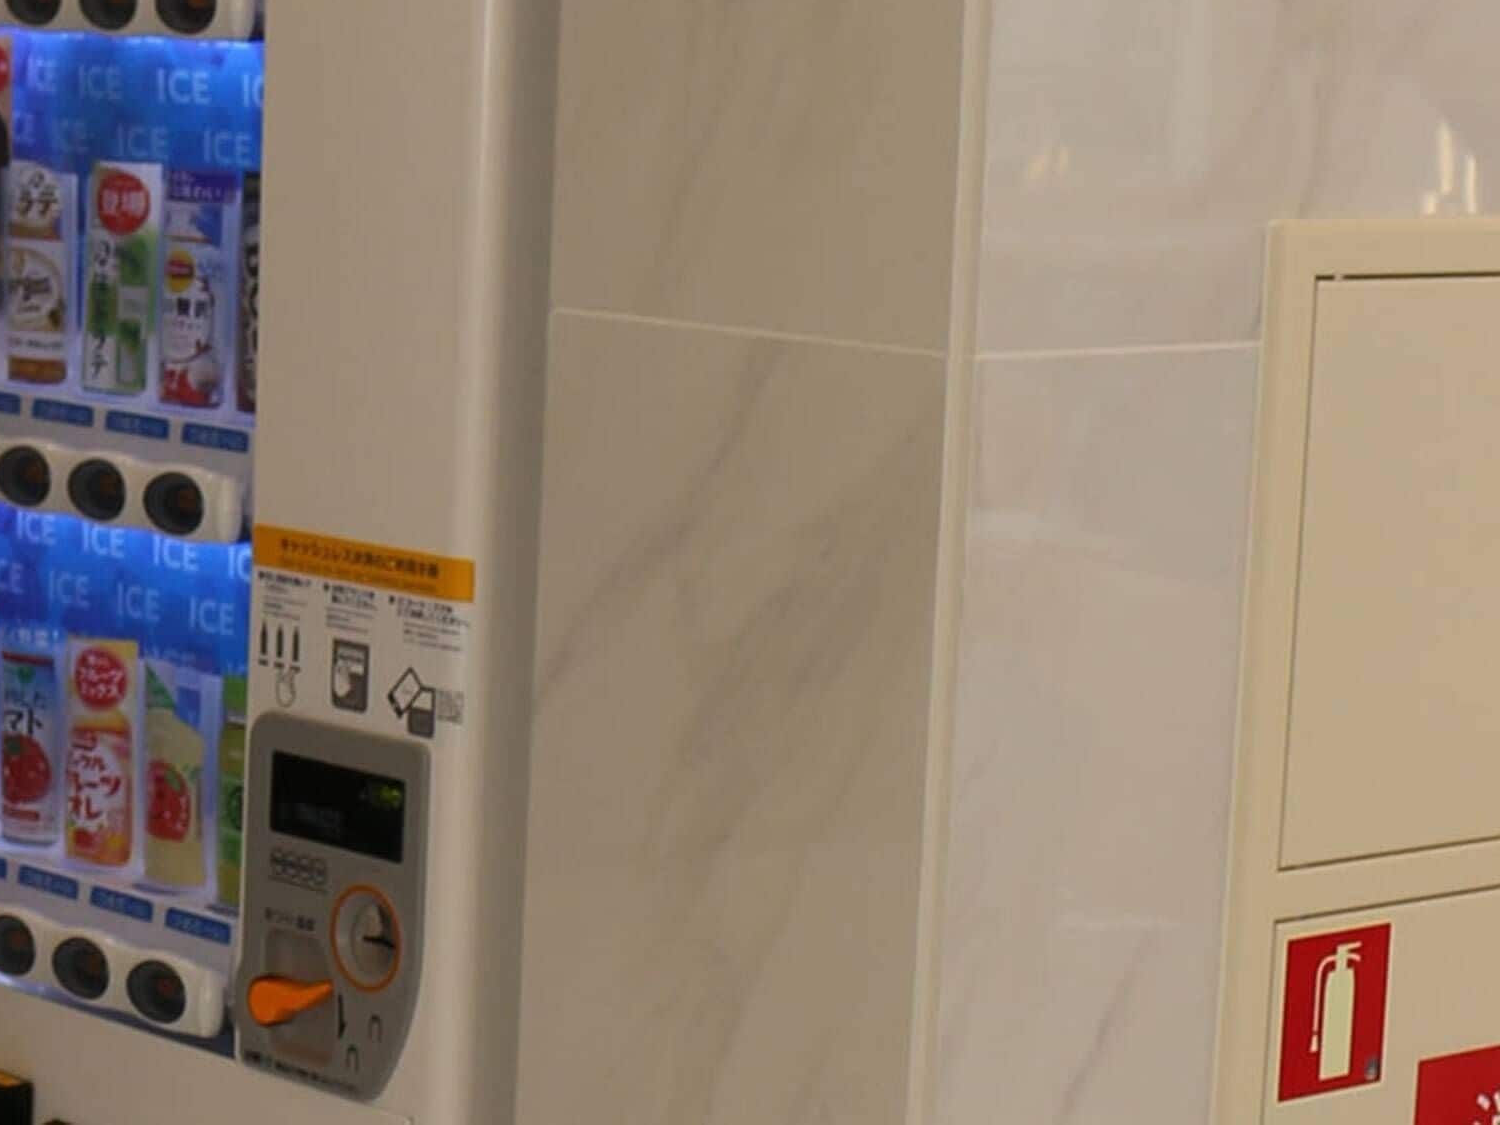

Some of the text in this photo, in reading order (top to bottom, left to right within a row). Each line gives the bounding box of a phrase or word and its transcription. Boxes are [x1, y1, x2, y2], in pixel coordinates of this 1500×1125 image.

[78, 65, 123, 100] ICE
[156, 66, 211, 106] ICE
[115, 122, 169, 160] ICE
[201, 129, 253, 166] ICE
[16, 510, 58, 547] ICE
[82, 521, 126, 559] ICE
[153, 533, 200, 573] ICE
[49, 570, 93, 611] ICE
[116, 581, 162, 622] ICE
[188, 593, 236, 637] ICE
